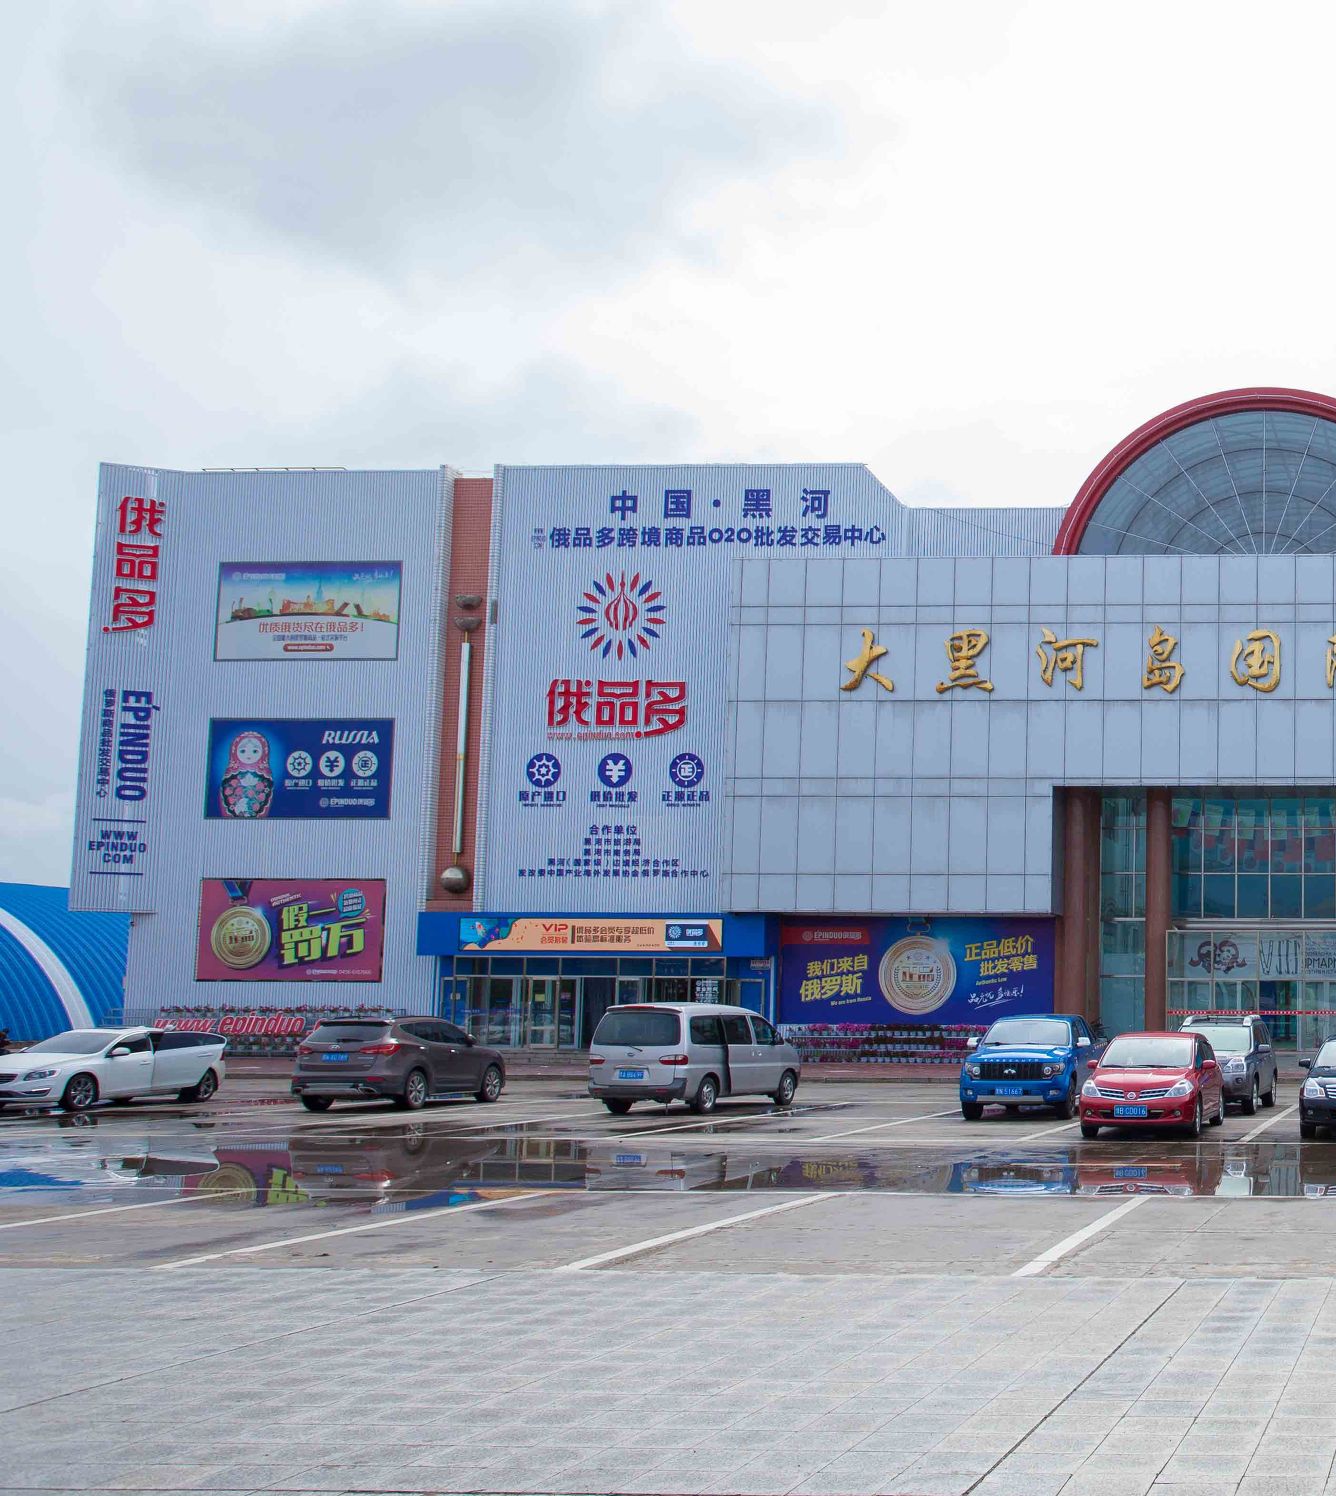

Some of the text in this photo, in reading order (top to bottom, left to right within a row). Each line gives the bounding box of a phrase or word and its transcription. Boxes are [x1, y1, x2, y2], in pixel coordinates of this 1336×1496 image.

[609, 488, 831, 521] 中国·黑河
[550, 524, 887, 549] 俄品多跨境商品O2O批发交易中心
[589, 824, 638, 836] 合作单位
[88, 840, 148, 854] EPINDUO
[102, 853, 135, 865] COM
[542, 923, 569, 932] VIP
[964, 934, 1034, 962] 正品低价
[806, 954, 869, 977] 我们来自
[980, 954, 1038, 977] 批发零售
[799, 972, 863, 1003] 俄罗斯
